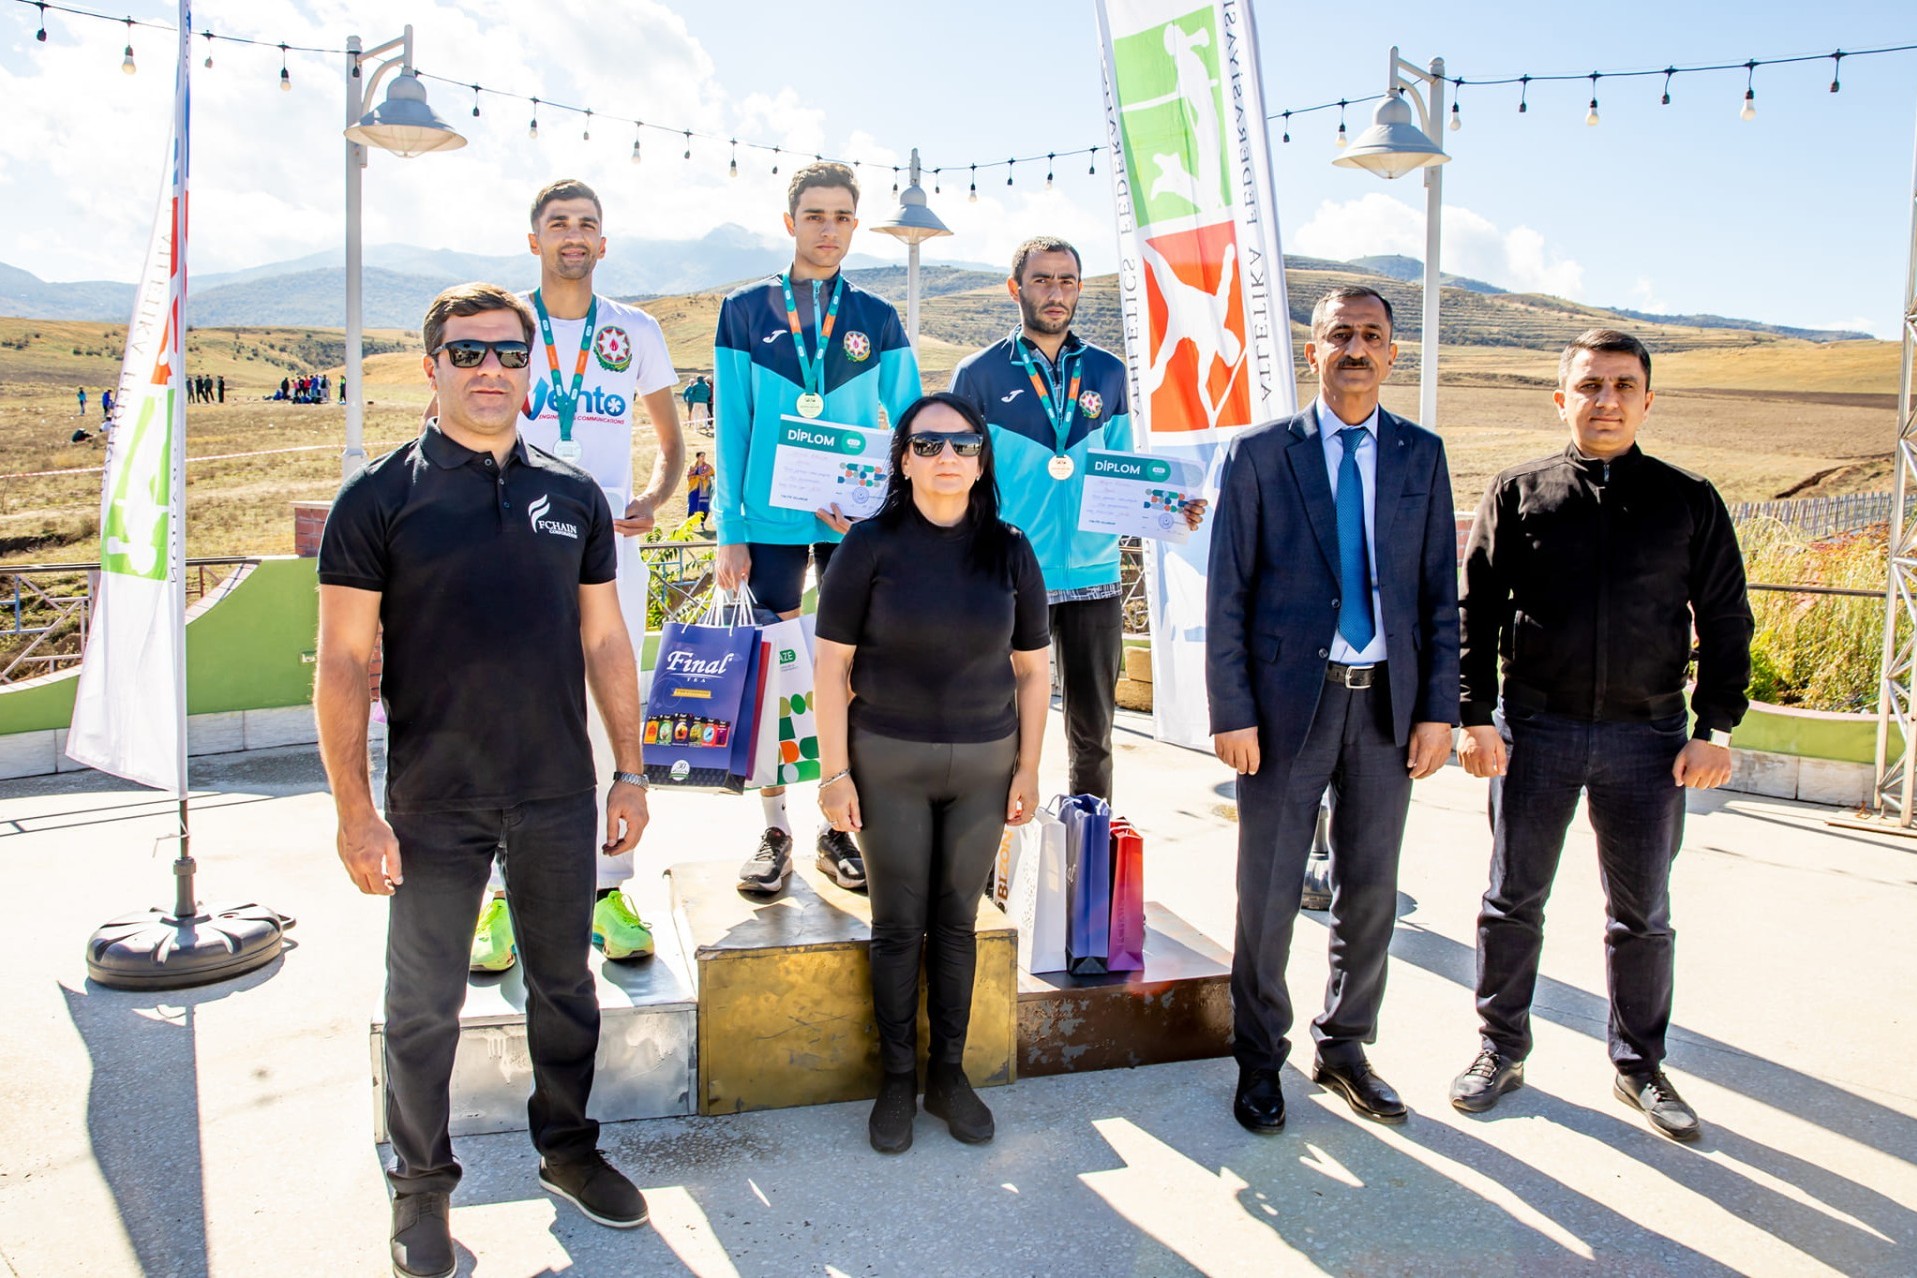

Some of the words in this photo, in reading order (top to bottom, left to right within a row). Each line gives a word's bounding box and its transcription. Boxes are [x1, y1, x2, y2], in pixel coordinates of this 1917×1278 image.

[787, 428, 835, 447] DİPLOM
[1094, 459, 1141, 475] DİPLOM
[666, 650, 734, 675] Final
